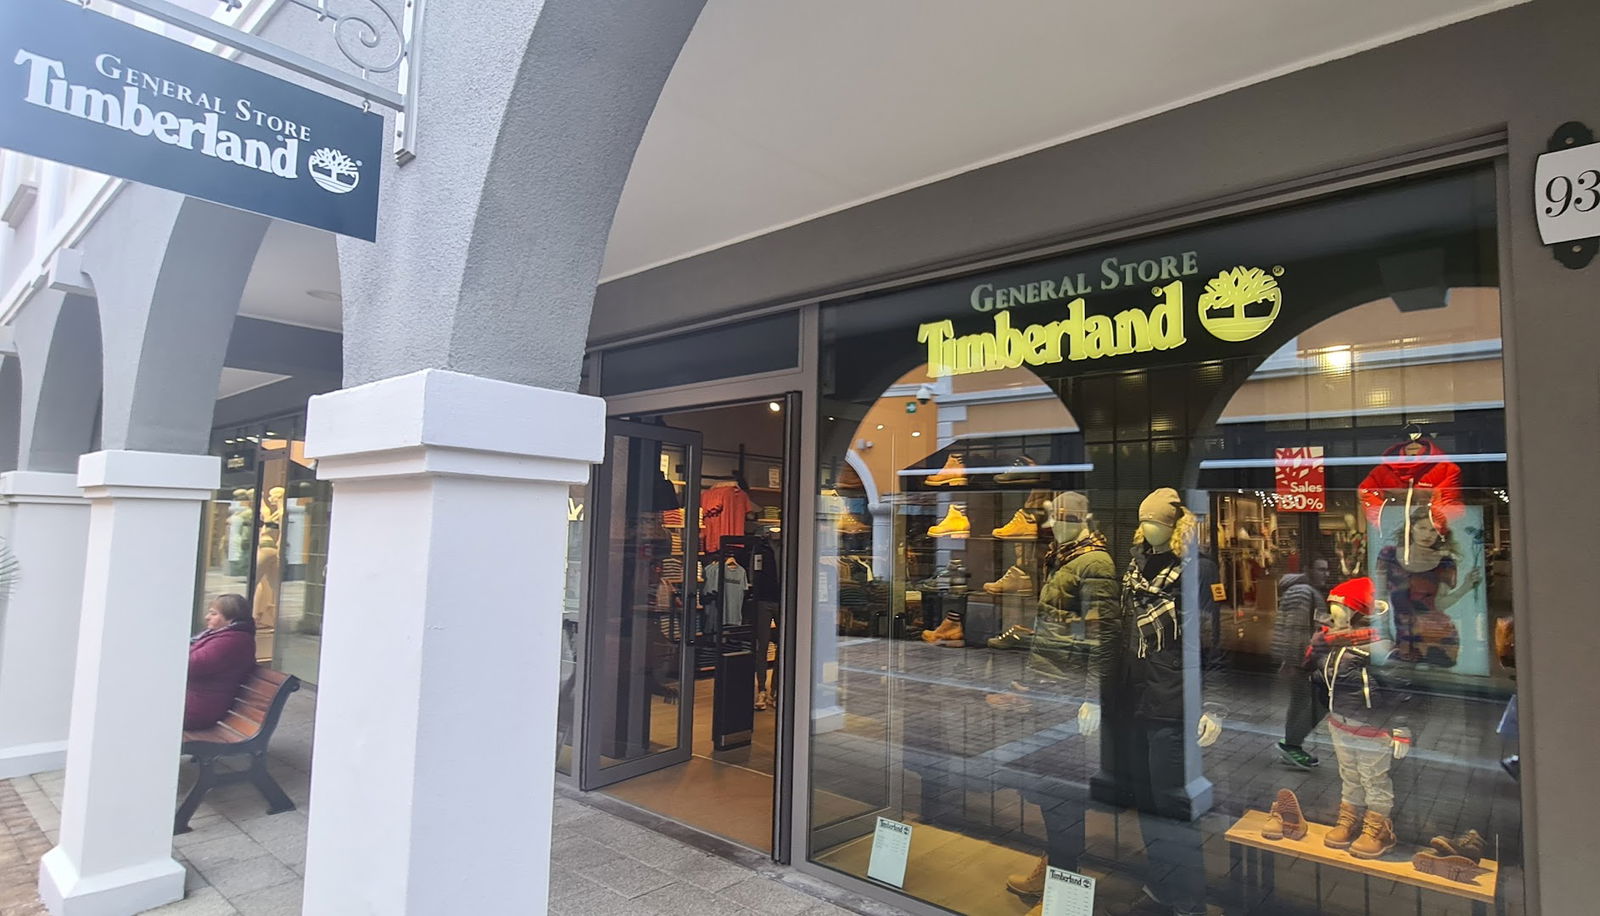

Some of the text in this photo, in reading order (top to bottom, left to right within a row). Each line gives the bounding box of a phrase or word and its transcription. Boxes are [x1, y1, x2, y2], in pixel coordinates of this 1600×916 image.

[14, 49, 298, 179] Timberland
[95, 54, 311, 142] GENERAL STORE
[1545, 169, 1600, 217] 93
[971, 251, 1198, 312] GENERAL STORE
[917, 280, 1186, 378] Timberland
[1290, 481, 1323, 493] Sales
[1050, 869, 1082, 886] Timberland
